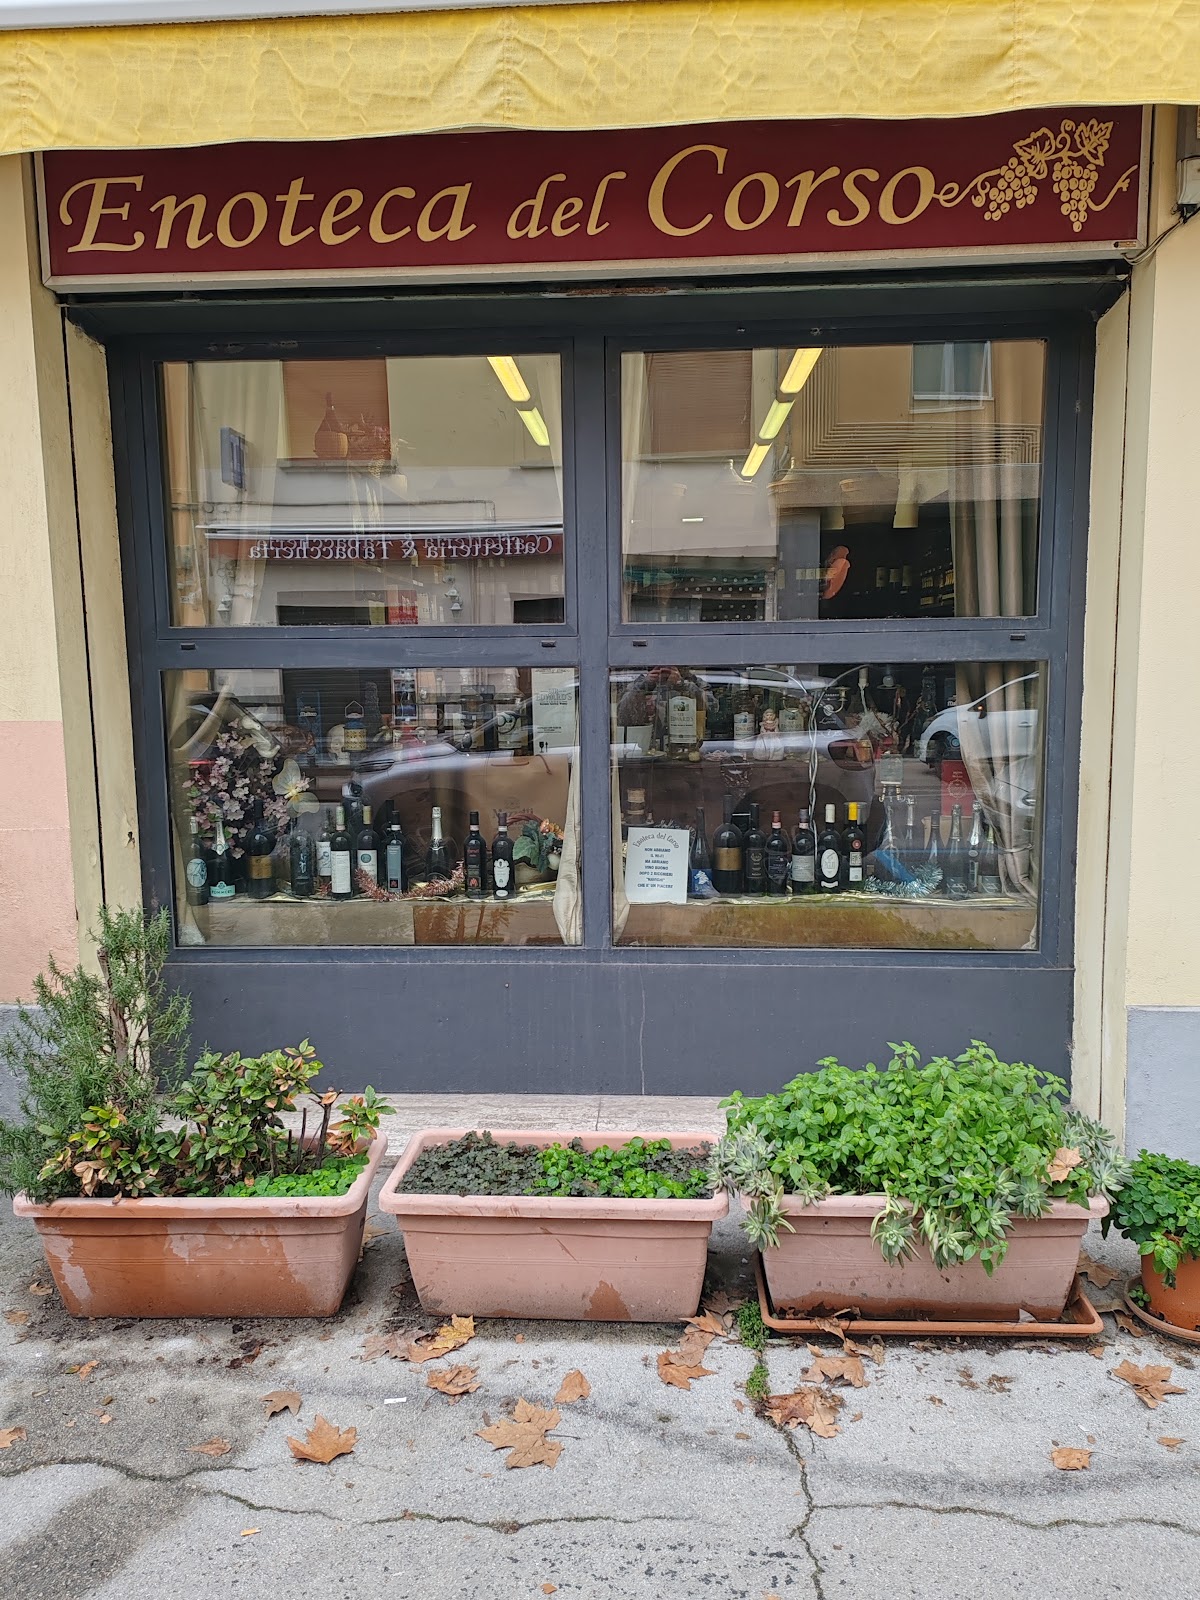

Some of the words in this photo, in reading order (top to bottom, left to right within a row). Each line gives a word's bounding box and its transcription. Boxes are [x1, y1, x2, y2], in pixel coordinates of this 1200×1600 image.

[59, 174, 477, 254] Enoteca
[506, 171, 627, 240] del
[647, 143, 937, 237] Corso
[632, 833, 655, 848] Enoteca
[656, 832, 666, 840] del
[666, 835, 680, 849] Corso
